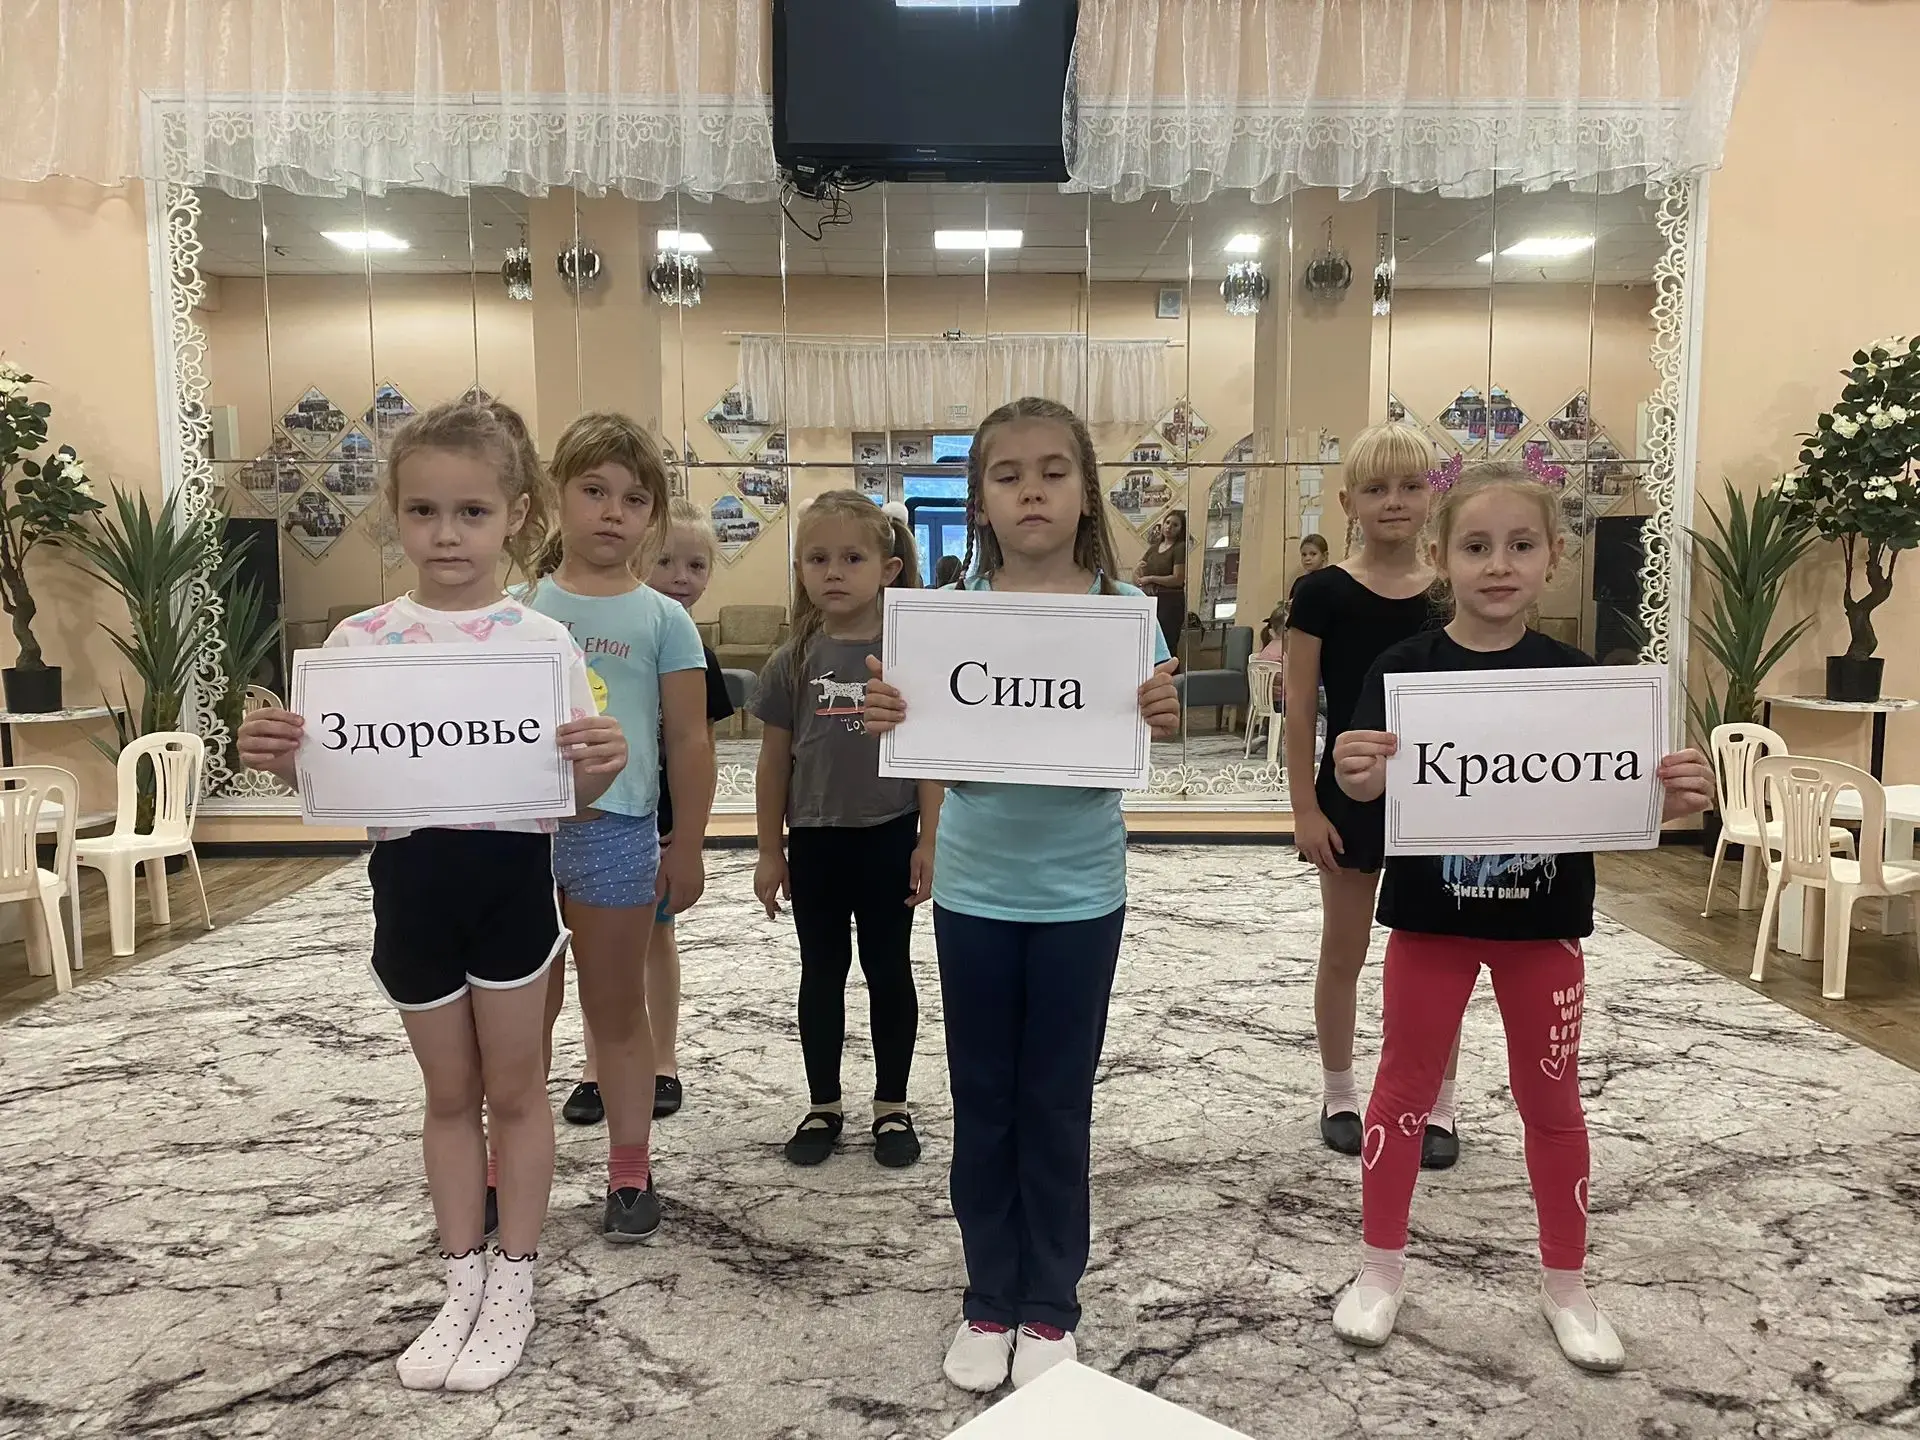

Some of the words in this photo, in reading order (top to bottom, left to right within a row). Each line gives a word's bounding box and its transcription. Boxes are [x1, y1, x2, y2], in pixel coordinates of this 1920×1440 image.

[575, 636, 630, 659] EMON
[949, 661, 1086, 710] Сила
[321, 712, 541, 759] Здоровье
[1412, 741, 1643, 798] Красота
[1453, 883, 1494, 899] SWEET
